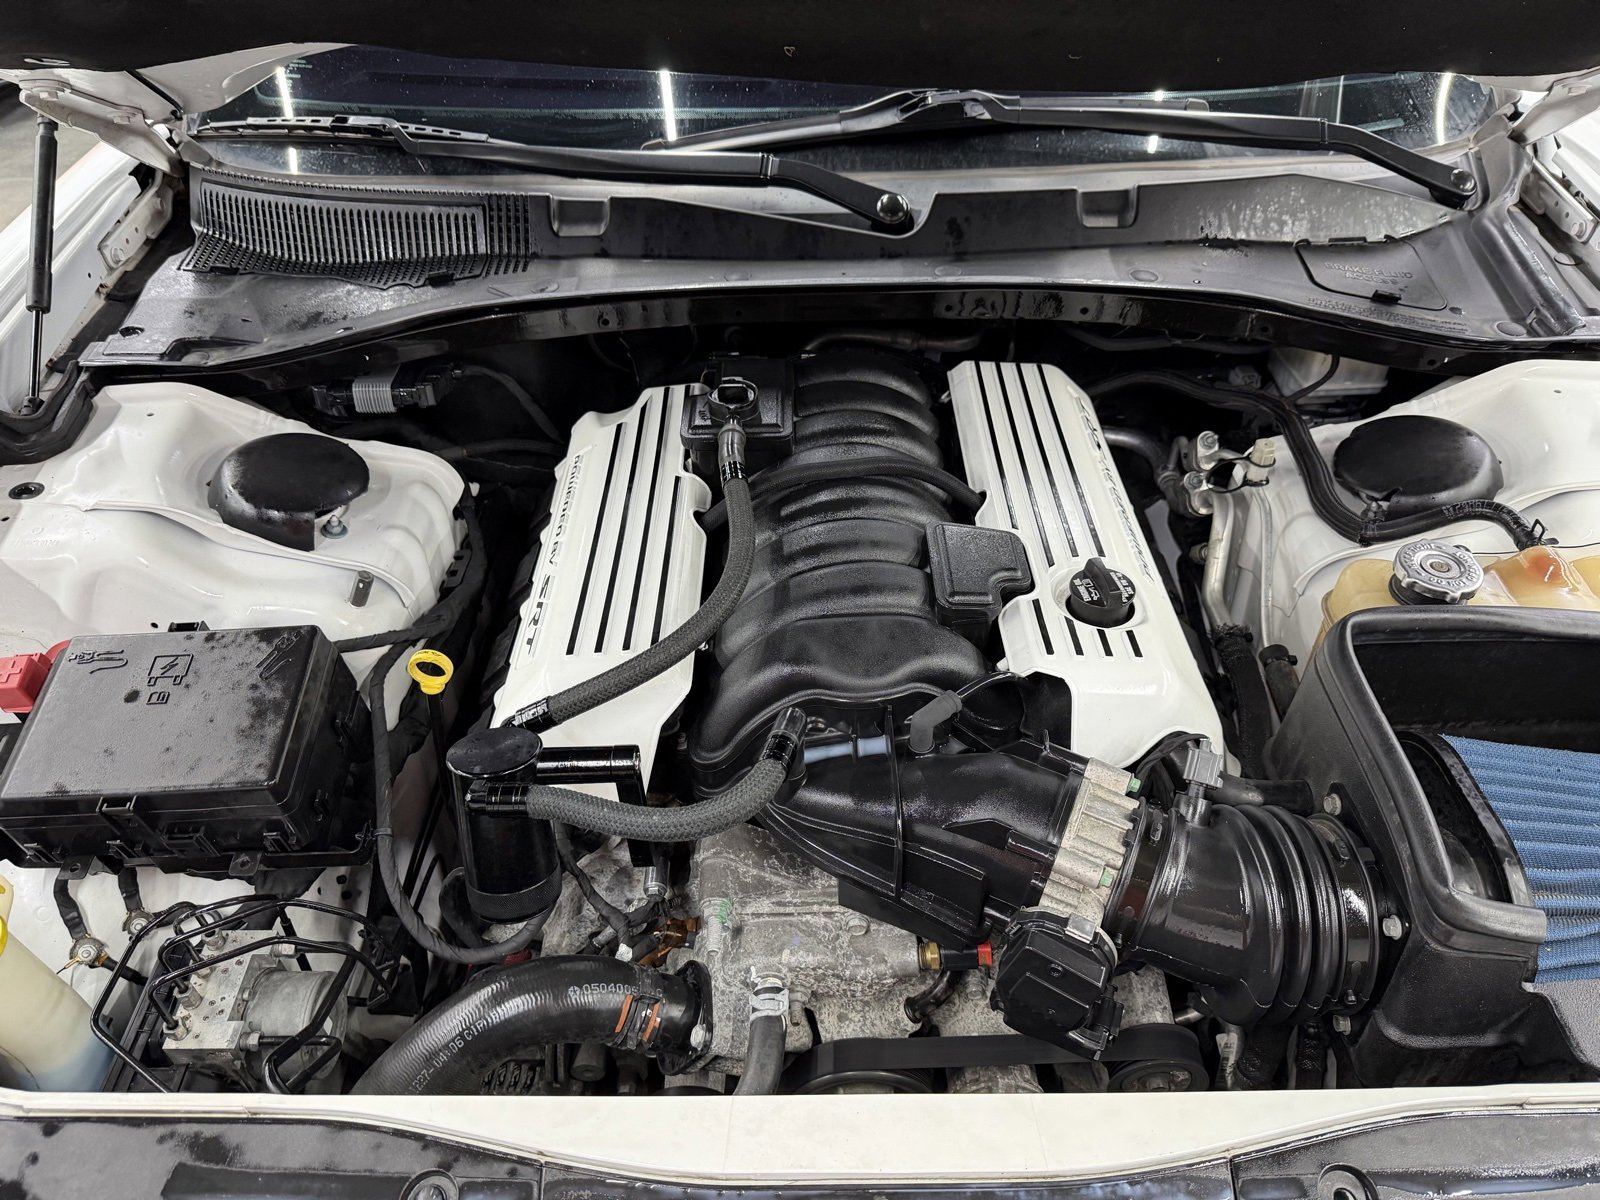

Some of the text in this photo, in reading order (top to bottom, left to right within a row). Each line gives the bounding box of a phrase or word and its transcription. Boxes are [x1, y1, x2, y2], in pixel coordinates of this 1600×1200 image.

[1324, 262, 1413, 279] BRAKE FLUID
[527, 573, 553, 656] SRT
